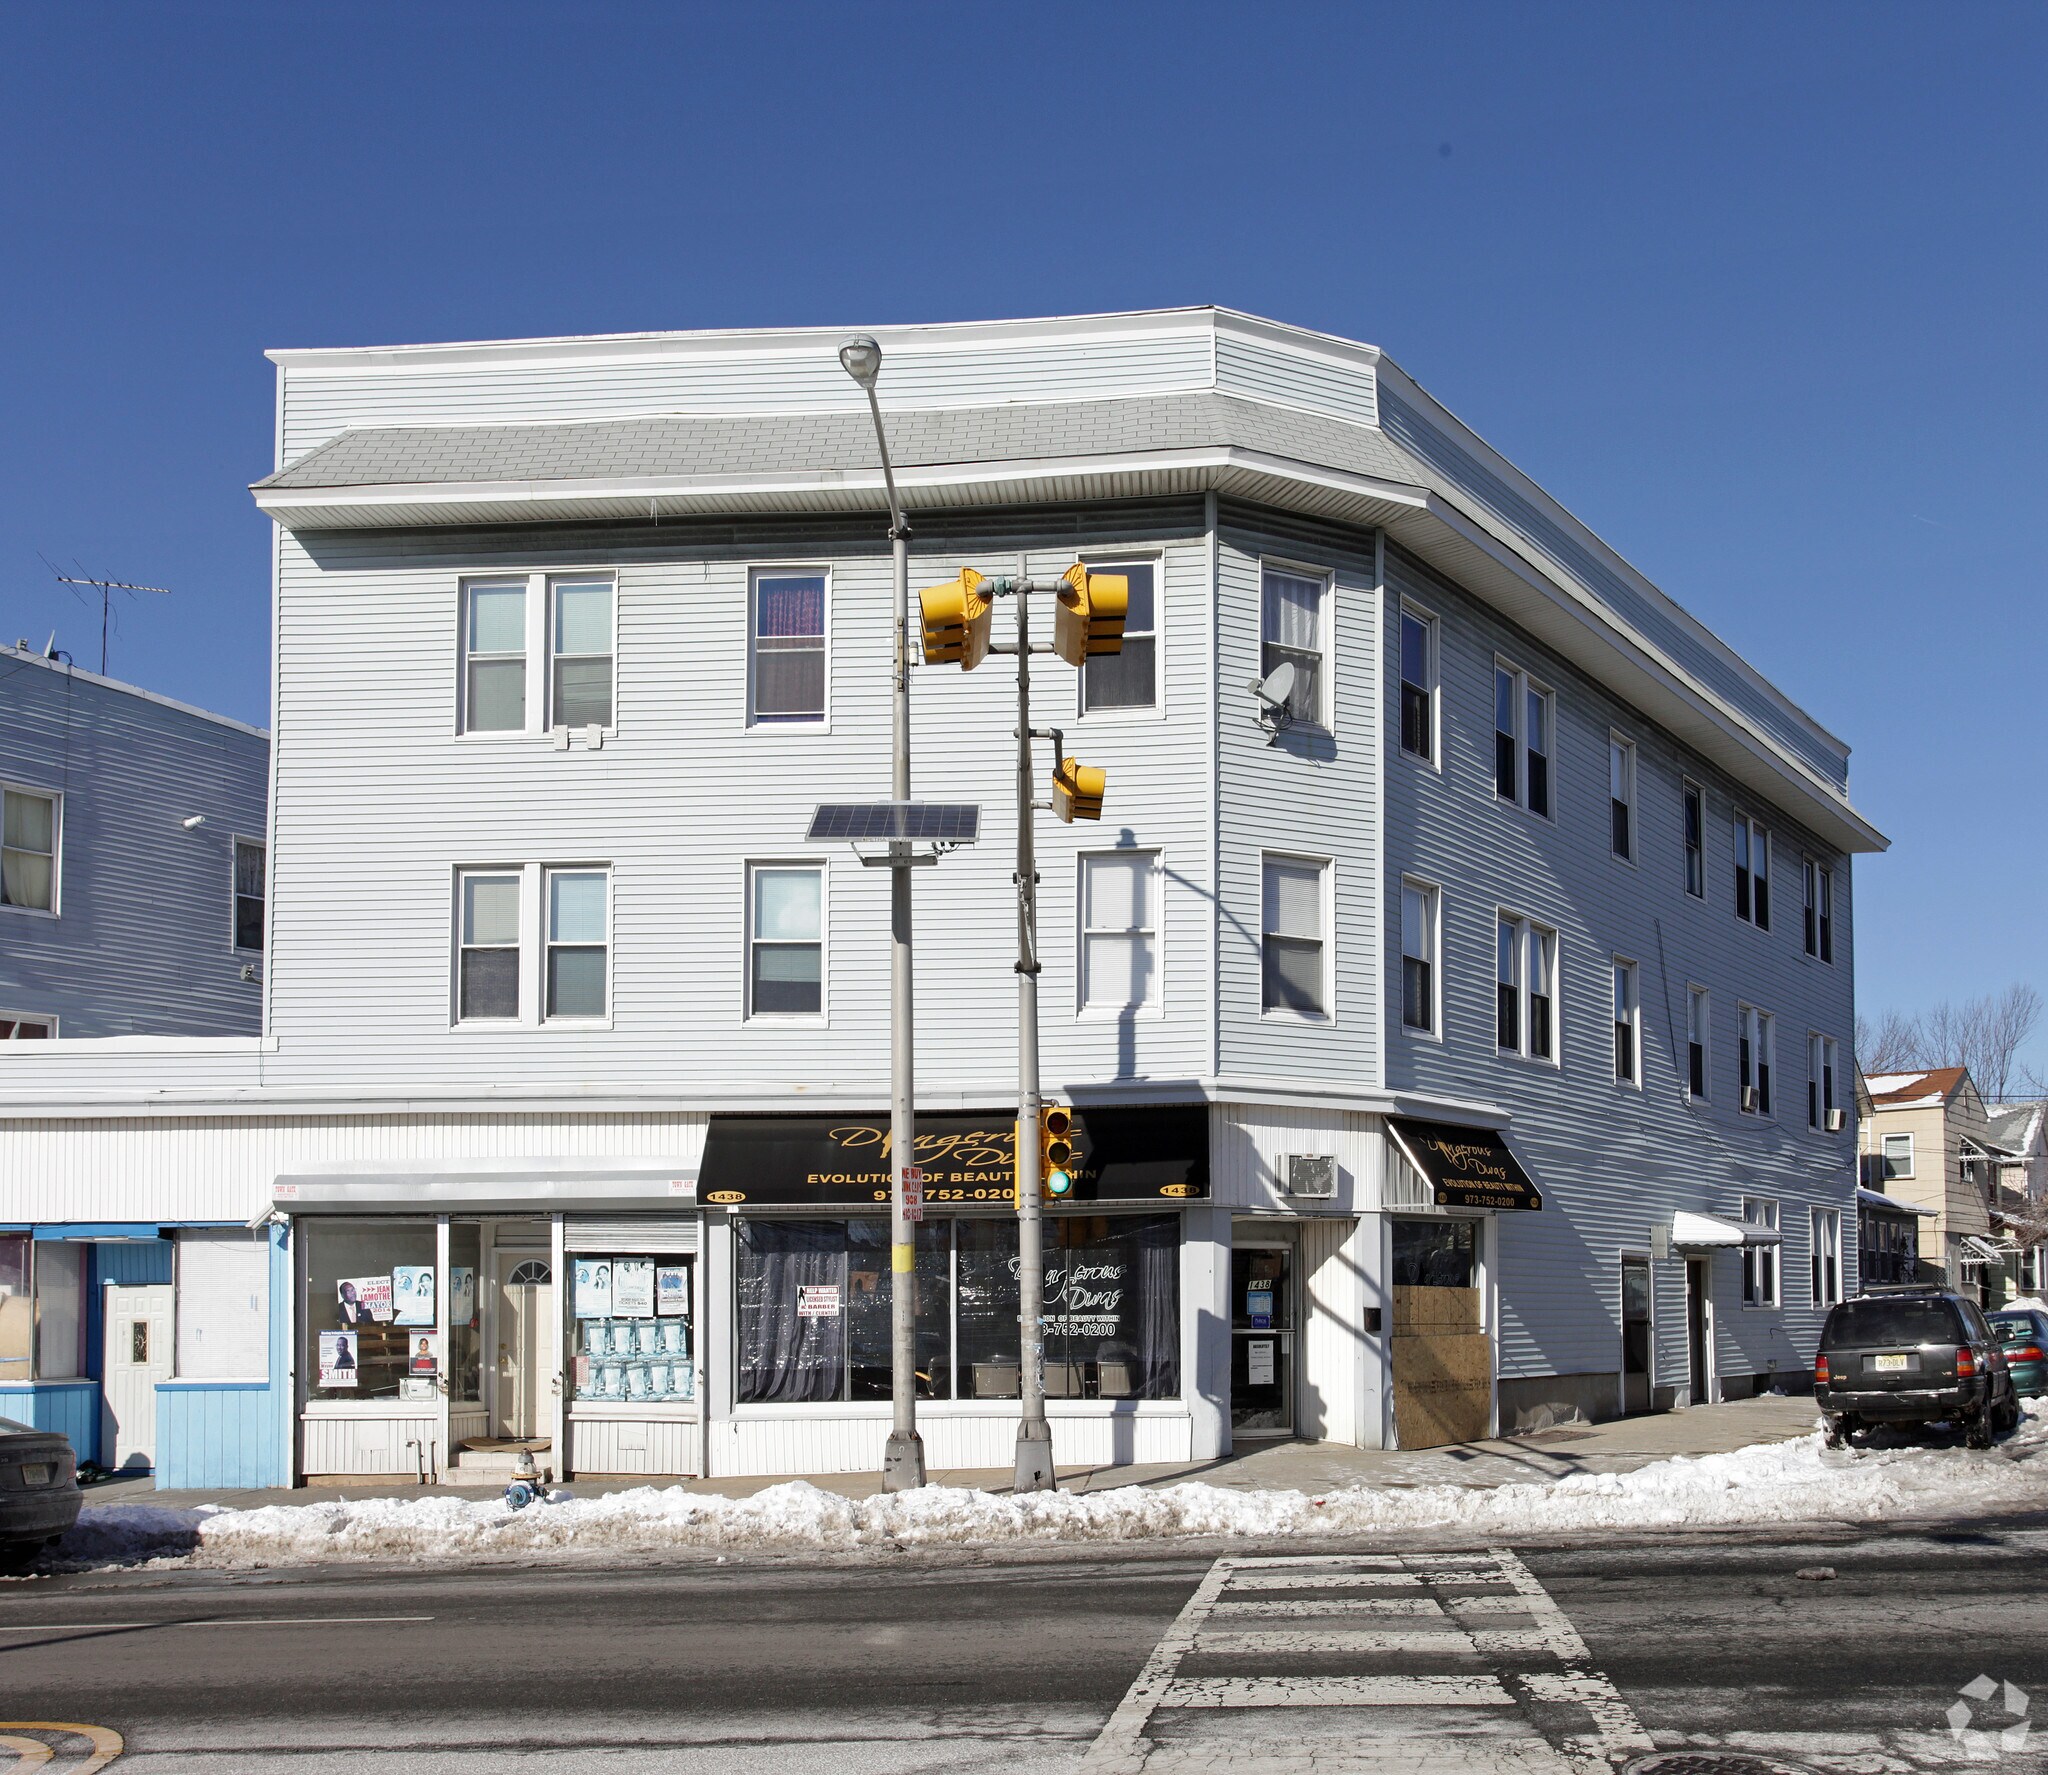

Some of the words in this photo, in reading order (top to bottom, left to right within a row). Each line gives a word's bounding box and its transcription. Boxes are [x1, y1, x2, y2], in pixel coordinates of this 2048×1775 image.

[911, 1168, 922, 1180] BUY
[922, 1173, 944, 1183] OF
[951, 1172, 1015, 1182] BEAUT
[1162, 1187, 1198, 1195] 1438
[711, 1192, 743, 1201] 1438
[1464, 1195, 1515, 1206] 973-752-0200
[1249, 1281, 1271, 1289] 1438
[360, 1292, 391, 1301] LAMOTHE
[1062, 1284, 1124, 1311] Divas
[364, 1301, 392, 1310] MAYOR
[321, 1368, 356, 1380] SMITH
